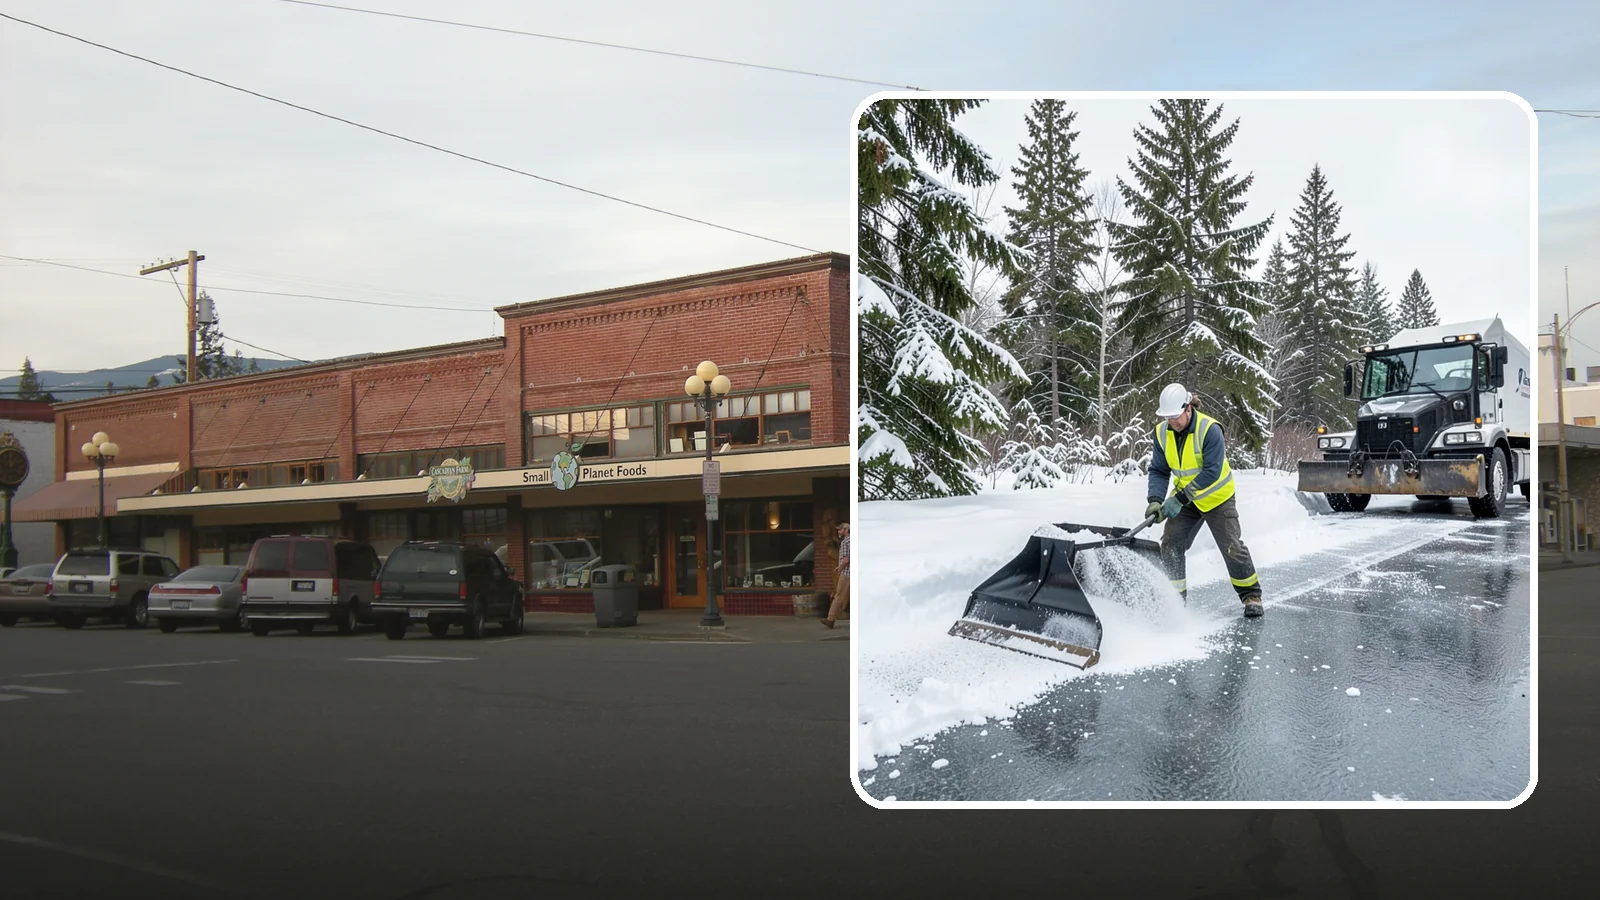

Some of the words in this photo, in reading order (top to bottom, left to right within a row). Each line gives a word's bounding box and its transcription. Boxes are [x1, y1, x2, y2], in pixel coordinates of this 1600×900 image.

[523, 471, 549, 483] Small
[583, 467, 614, 479] Planet
[617, 464, 647, 477] Foods
